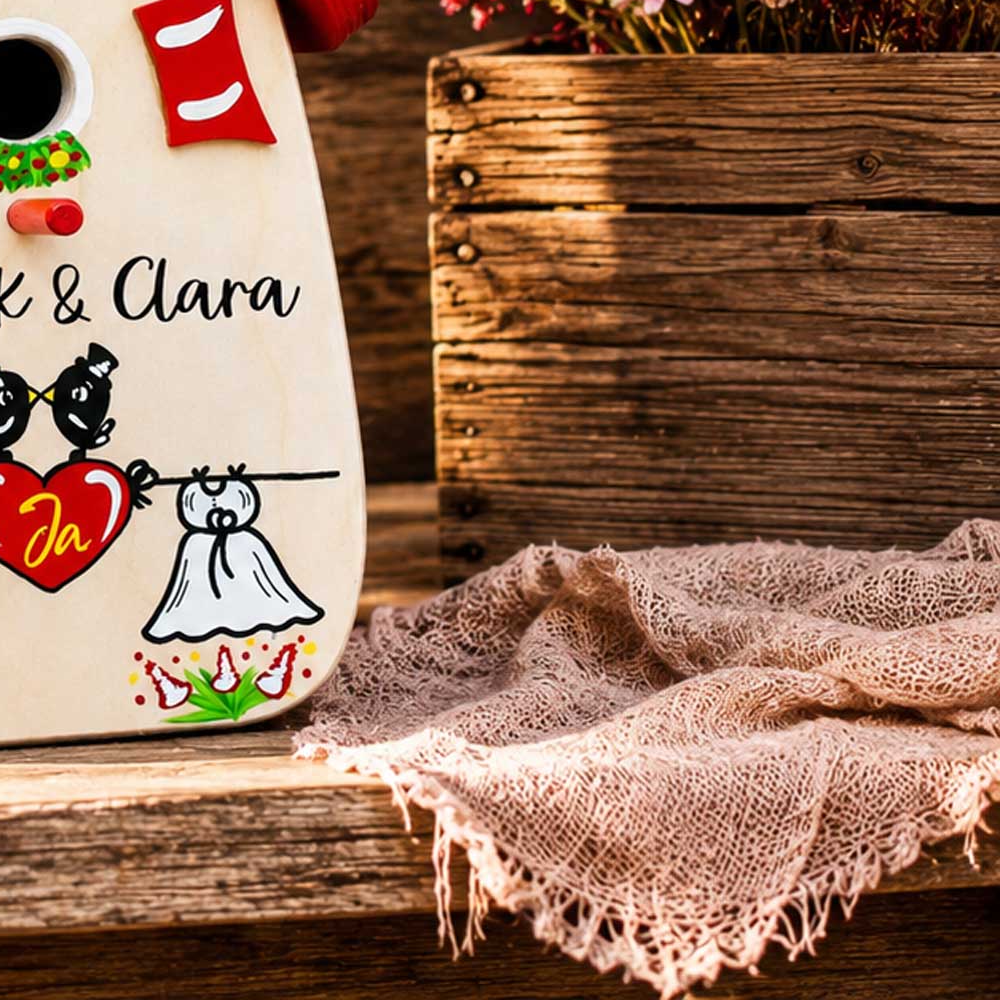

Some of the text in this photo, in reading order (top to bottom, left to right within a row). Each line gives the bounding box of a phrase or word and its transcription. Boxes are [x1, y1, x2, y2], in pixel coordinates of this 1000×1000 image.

[52, 263, 92, 325] &
[112, 255, 301, 323] Clara
[19, 493, 92, 568] Ja
